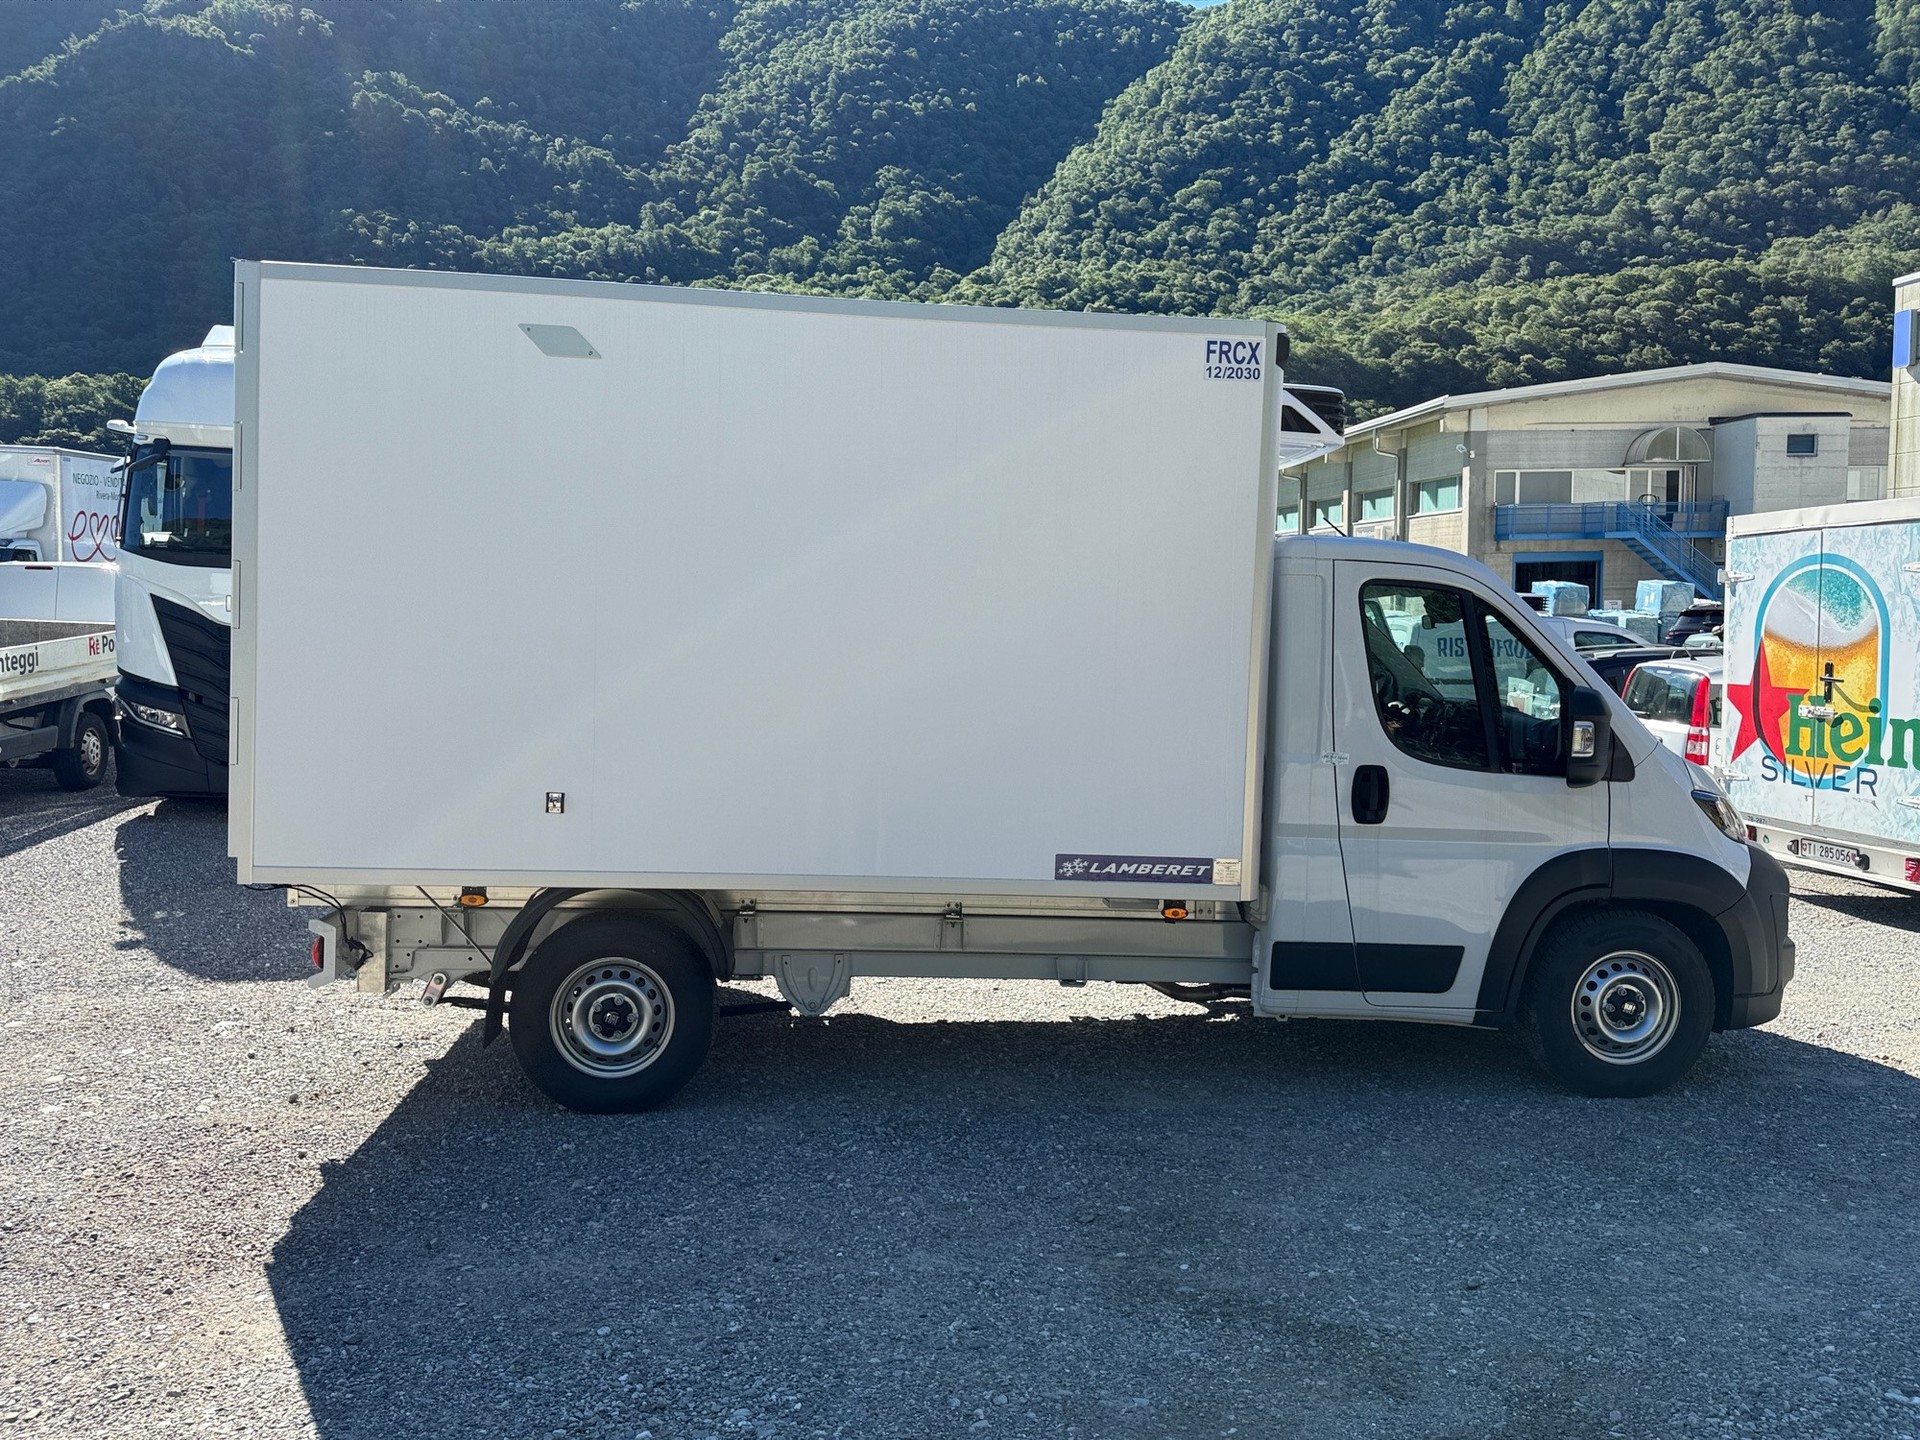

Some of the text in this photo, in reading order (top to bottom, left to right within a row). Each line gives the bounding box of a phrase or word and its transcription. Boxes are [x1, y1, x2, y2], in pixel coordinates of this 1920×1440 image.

[1206, 340, 1261, 365] FRCX
[1206, 366, 1261, 380] 12/2030
[72, 472, 99, 486] NEGOZIO
[1761, 754, 1877, 797] SILVER
[1819, 845, 1851, 863] 285056
[1089, 862, 1211, 877] LAMBERET
